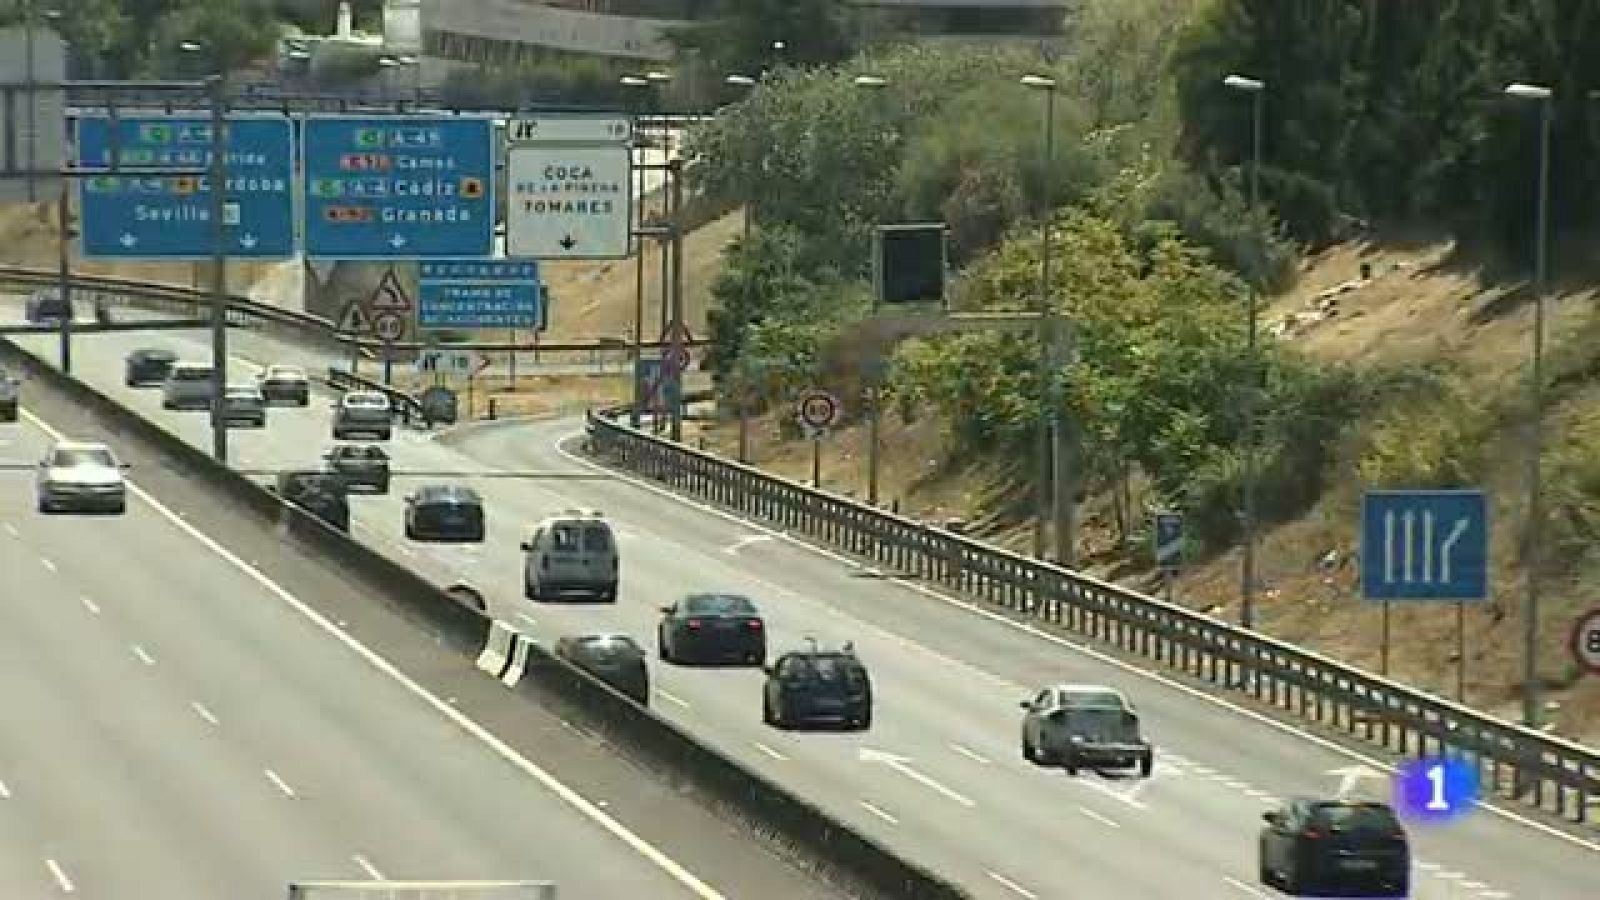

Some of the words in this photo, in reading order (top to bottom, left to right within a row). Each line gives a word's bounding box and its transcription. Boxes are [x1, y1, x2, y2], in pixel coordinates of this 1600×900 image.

[199, 178, 285, 191] Crdoba
[134, 204, 210, 221] Sevilla
[524, 199, 613, 213] TOMARES
[382, 206, 471, 222] Granada
